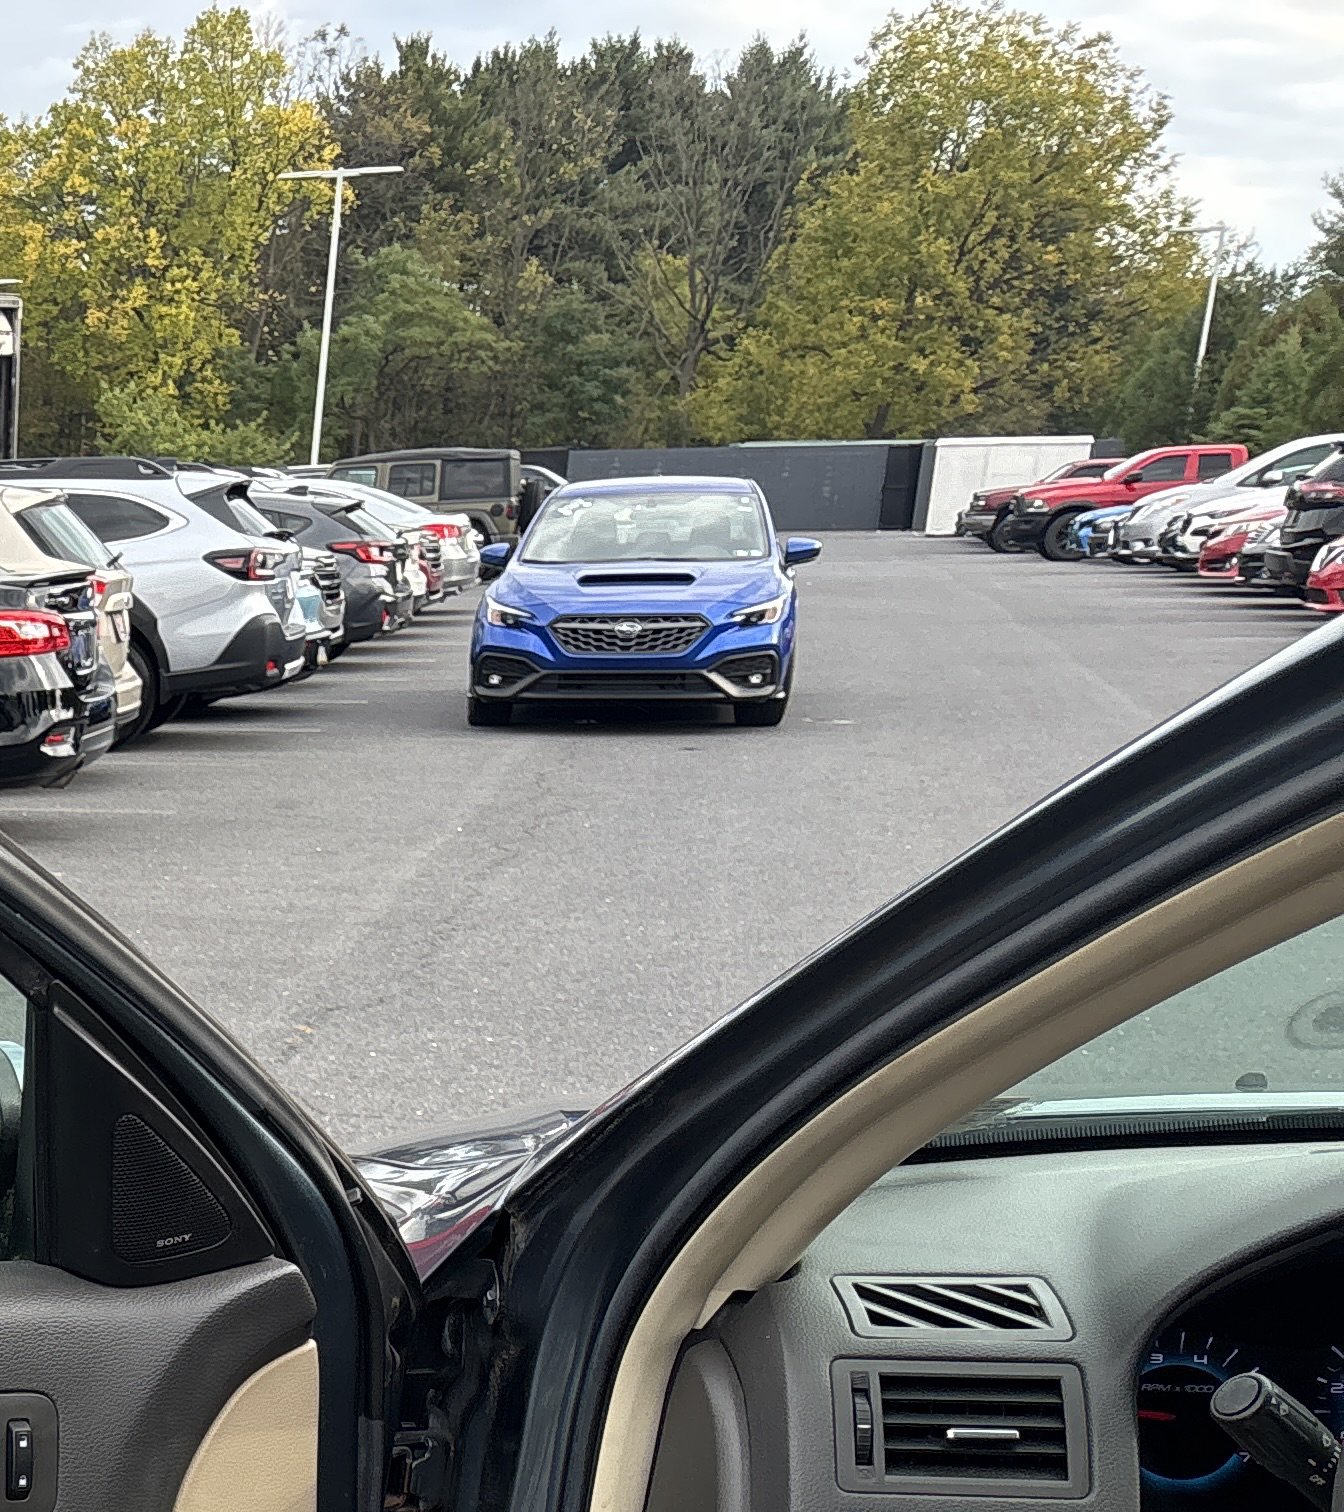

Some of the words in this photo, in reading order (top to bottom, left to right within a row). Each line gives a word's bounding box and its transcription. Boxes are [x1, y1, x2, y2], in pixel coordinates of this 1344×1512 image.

[156, 1233, 192, 1247] SONY
[1149, 1353, 1164, 1364] 3
[1193, 1355, 1208, 1365] 4
[1141, 1383, 1172, 1392] RPM
[1184, 1384, 1215, 1393] 1000
